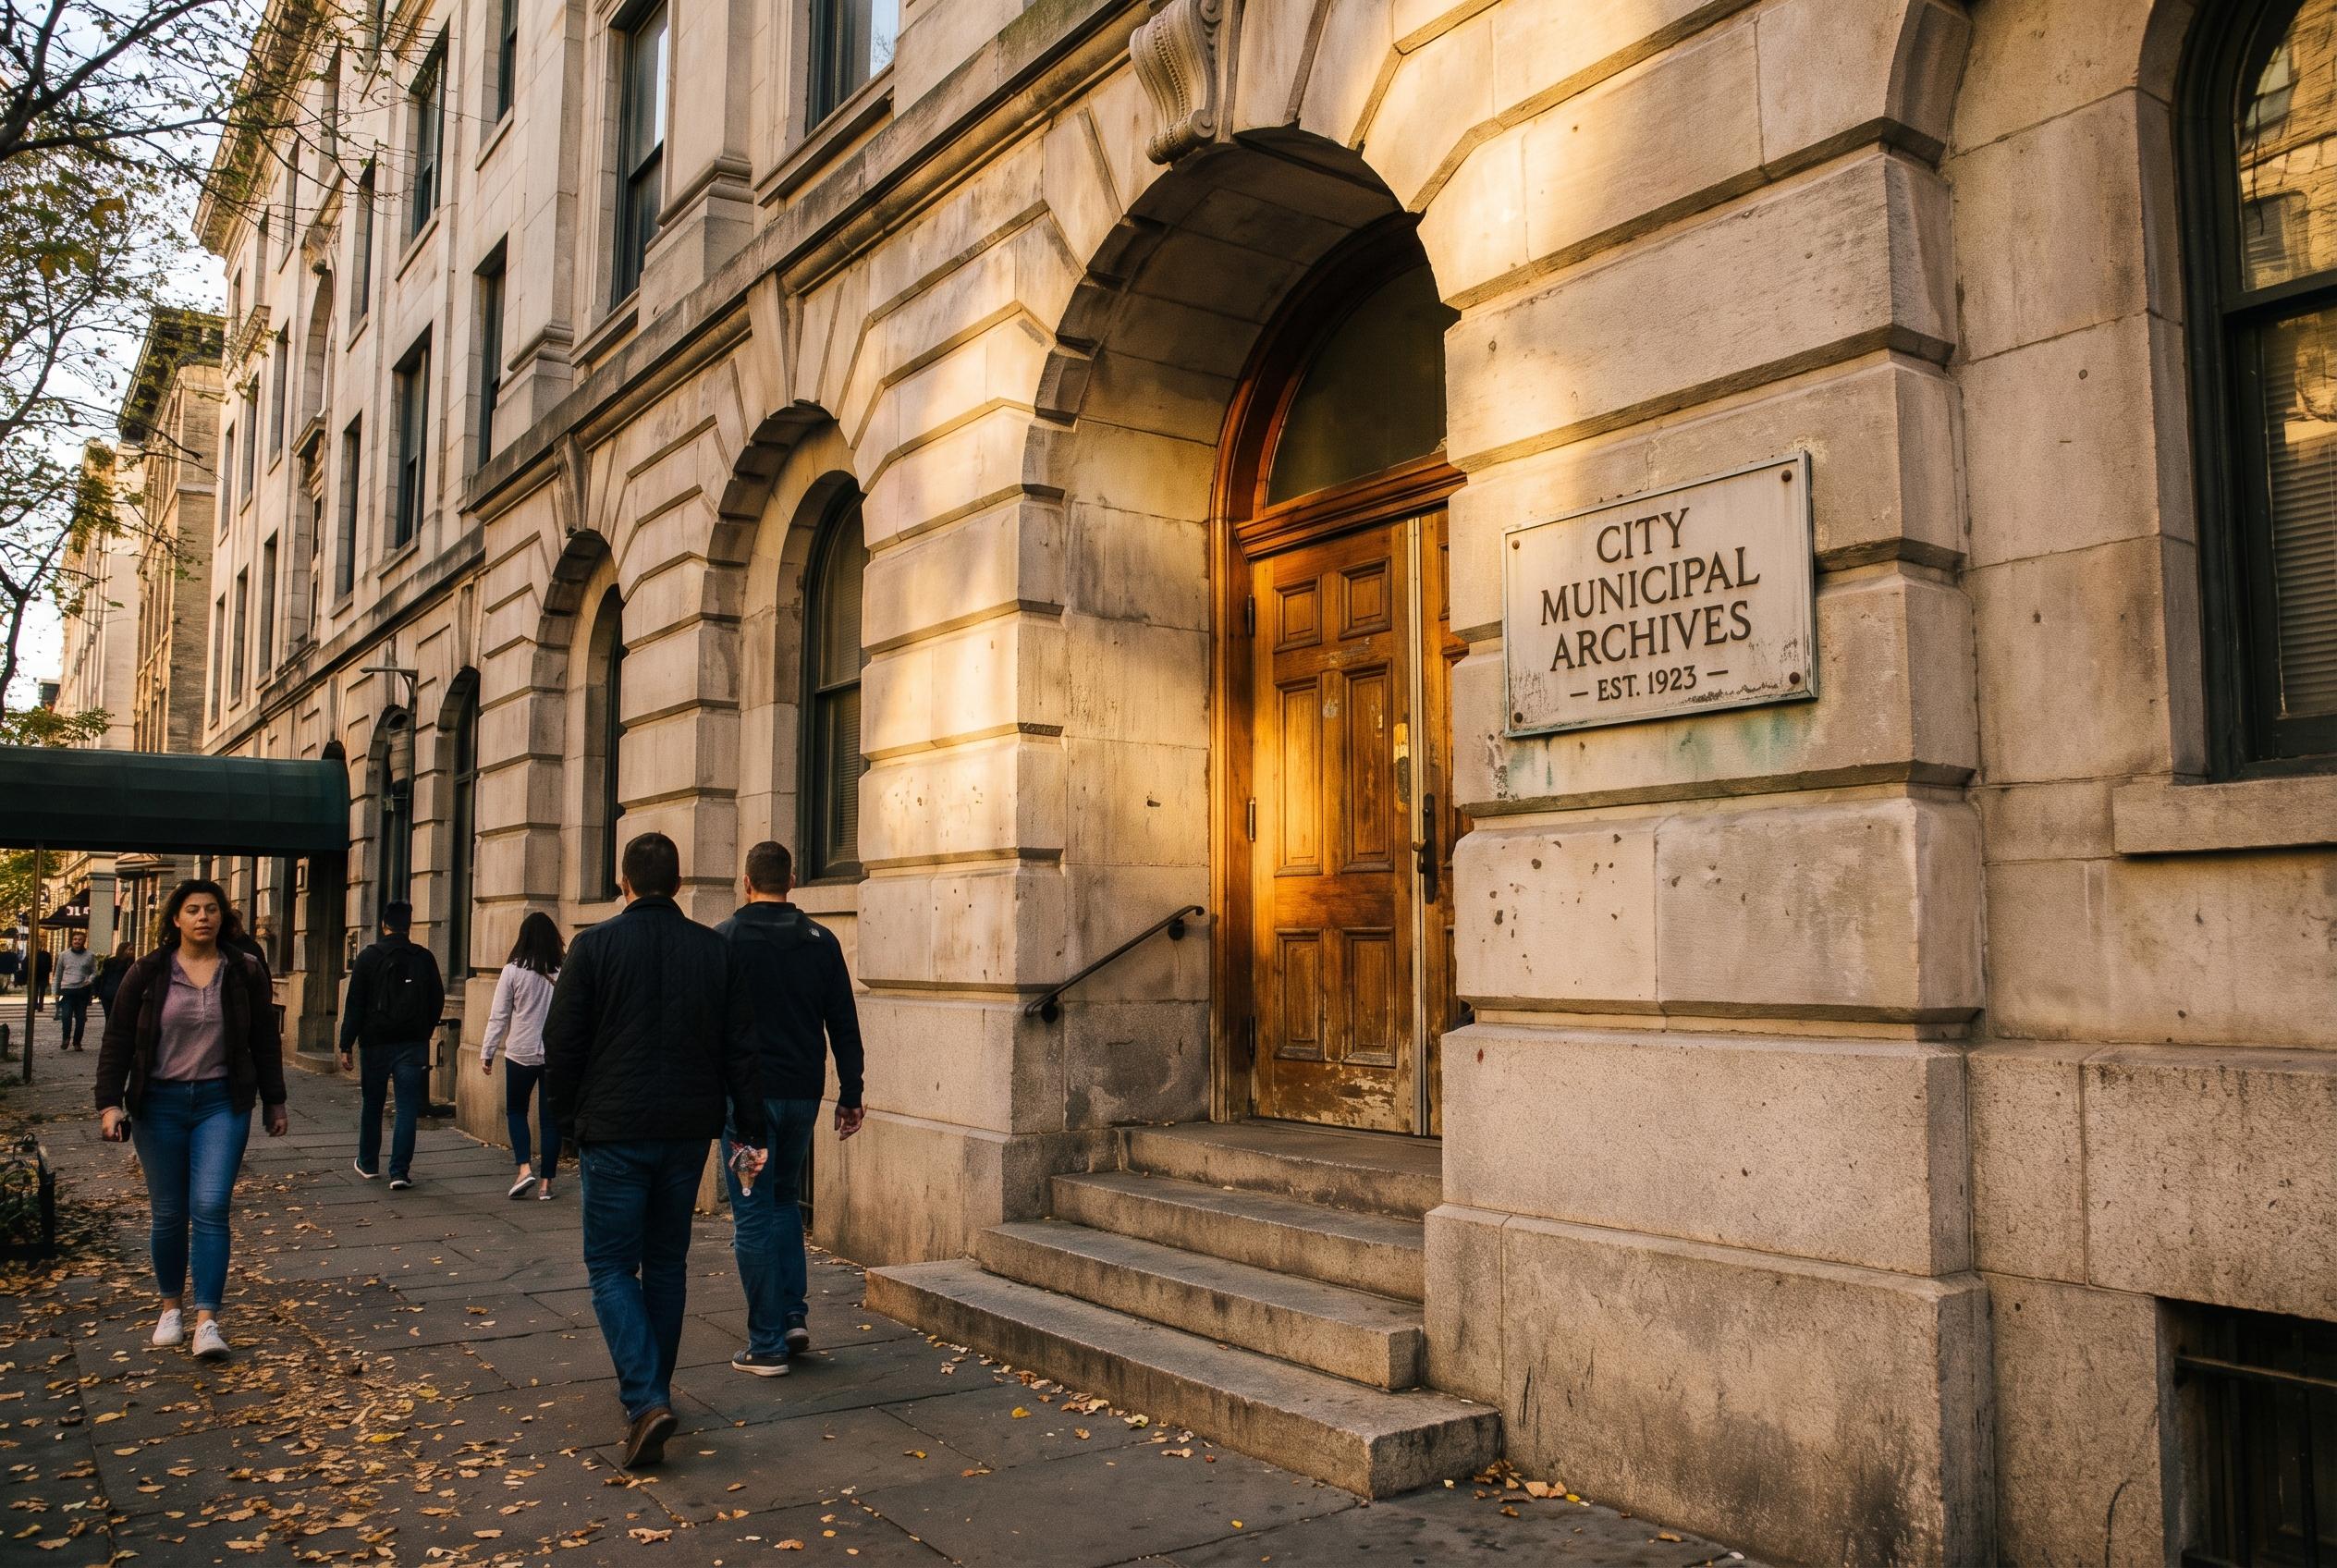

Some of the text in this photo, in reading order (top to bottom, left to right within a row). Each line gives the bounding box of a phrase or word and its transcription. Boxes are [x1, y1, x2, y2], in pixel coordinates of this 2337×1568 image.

[1597, 507, 1690, 563] CITY
[1541, 546, 1760, 626] MUNICIPAL
[1549, 600, 1752, 672] ARCHIVES
[1597, 664, 1697, 702] EST. 1923
